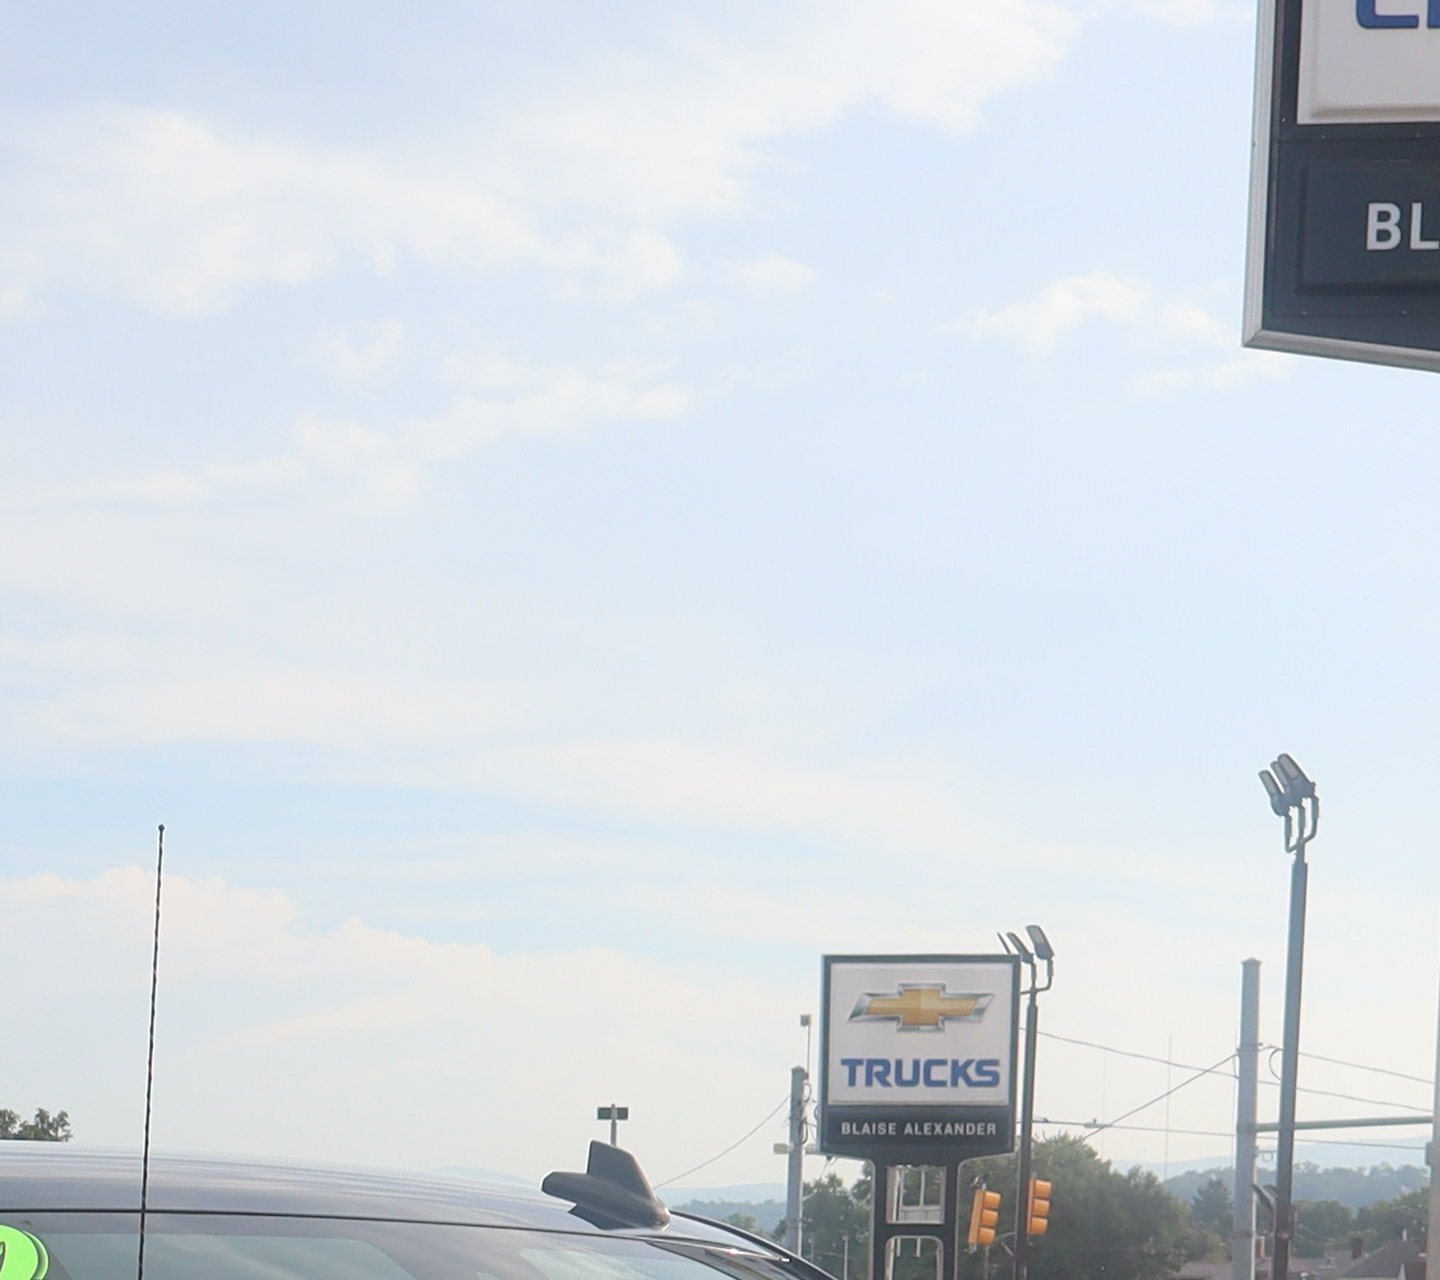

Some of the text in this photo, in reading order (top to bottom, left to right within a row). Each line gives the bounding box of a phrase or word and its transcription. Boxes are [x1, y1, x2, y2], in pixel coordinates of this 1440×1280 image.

[840, 1058, 1000, 1088] TRUCKS
[840, 1121, 997, 1136] BLAISE ALEXANDER
